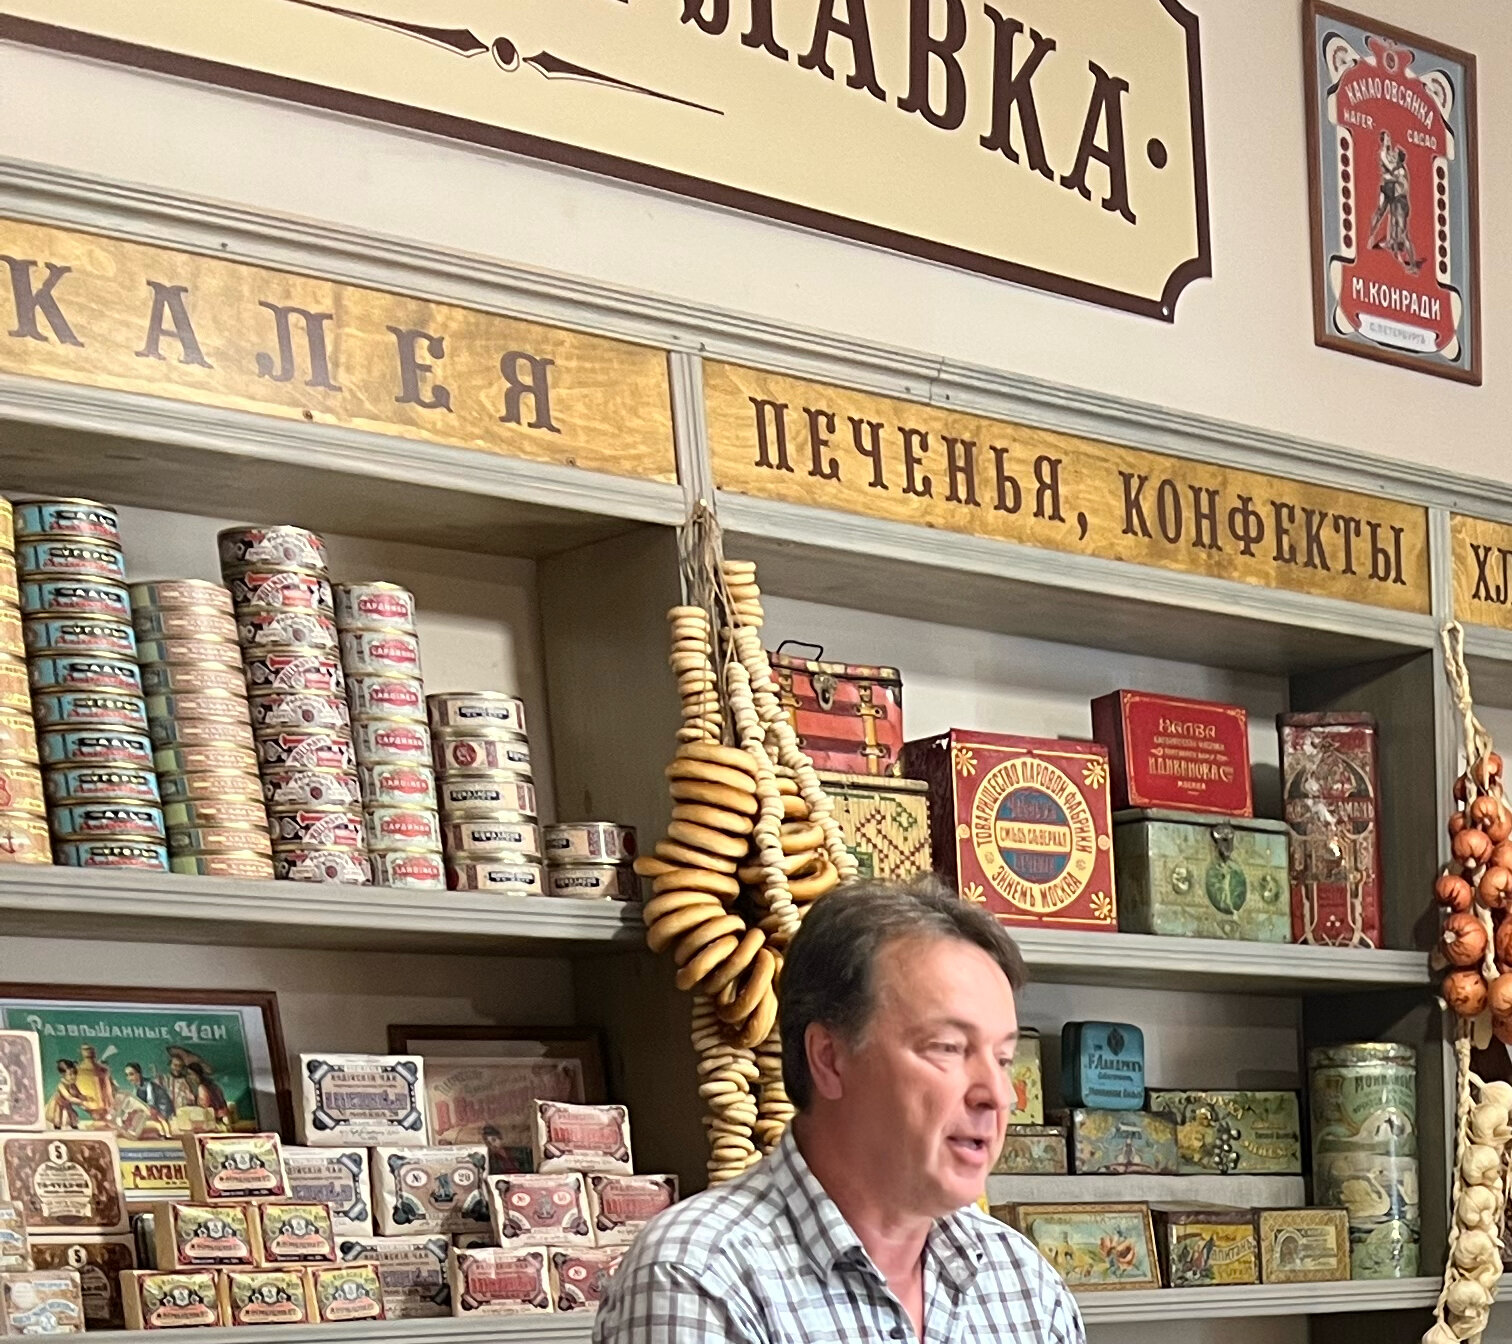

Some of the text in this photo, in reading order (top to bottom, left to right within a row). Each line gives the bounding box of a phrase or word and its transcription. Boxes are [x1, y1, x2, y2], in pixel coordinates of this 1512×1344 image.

[1344, 77, 1434, 130] КАКАО ОВСЯНКА
[3, 255, 561, 433] КАЛЕЯ
[749, 395, 1408, 586] ПЕЧЕНЬЯ, КОНФЕКТЫ
[1039, 871, 1083, 909] МОСКВА
